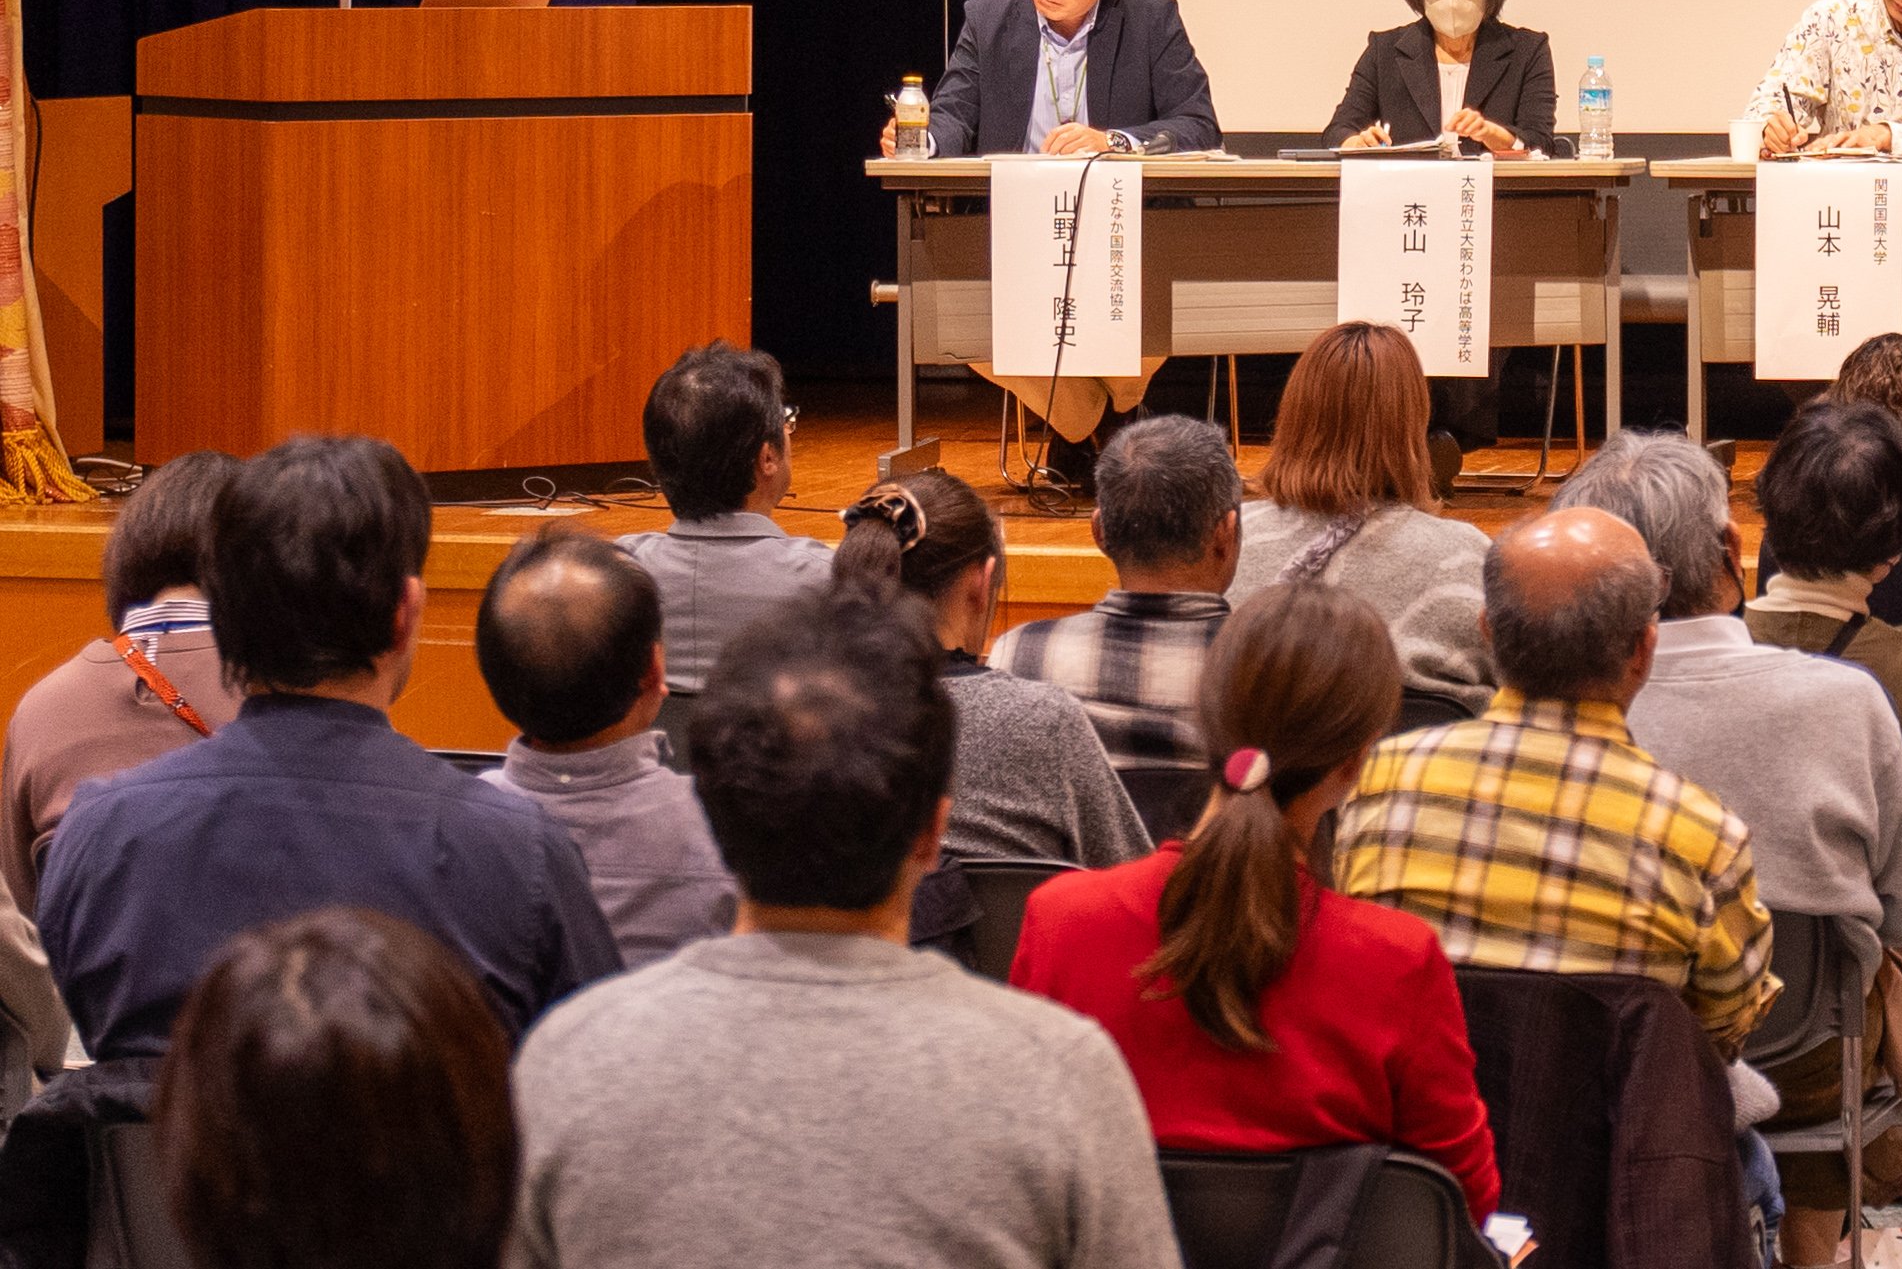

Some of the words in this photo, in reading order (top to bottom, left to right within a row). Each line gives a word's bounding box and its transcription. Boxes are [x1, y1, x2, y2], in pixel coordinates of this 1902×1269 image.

[1053, 190, 1077, 267] 山野上
[1403, 202, 1428, 254] 森山
[1817, 205, 1841, 257] 山本
[1873, 178, 1888, 266] 関西国際大学
[1110, 177, 1124, 322] とよなか国際交流協会
[1458, 175, 1475, 363] 大阪府立大阪わかば高等学校
[1052, 296, 1077, 347] 隆史
[1401, 282, 1426, 333] 玲子
[1816, 285, 1841, 337] 晃輔
